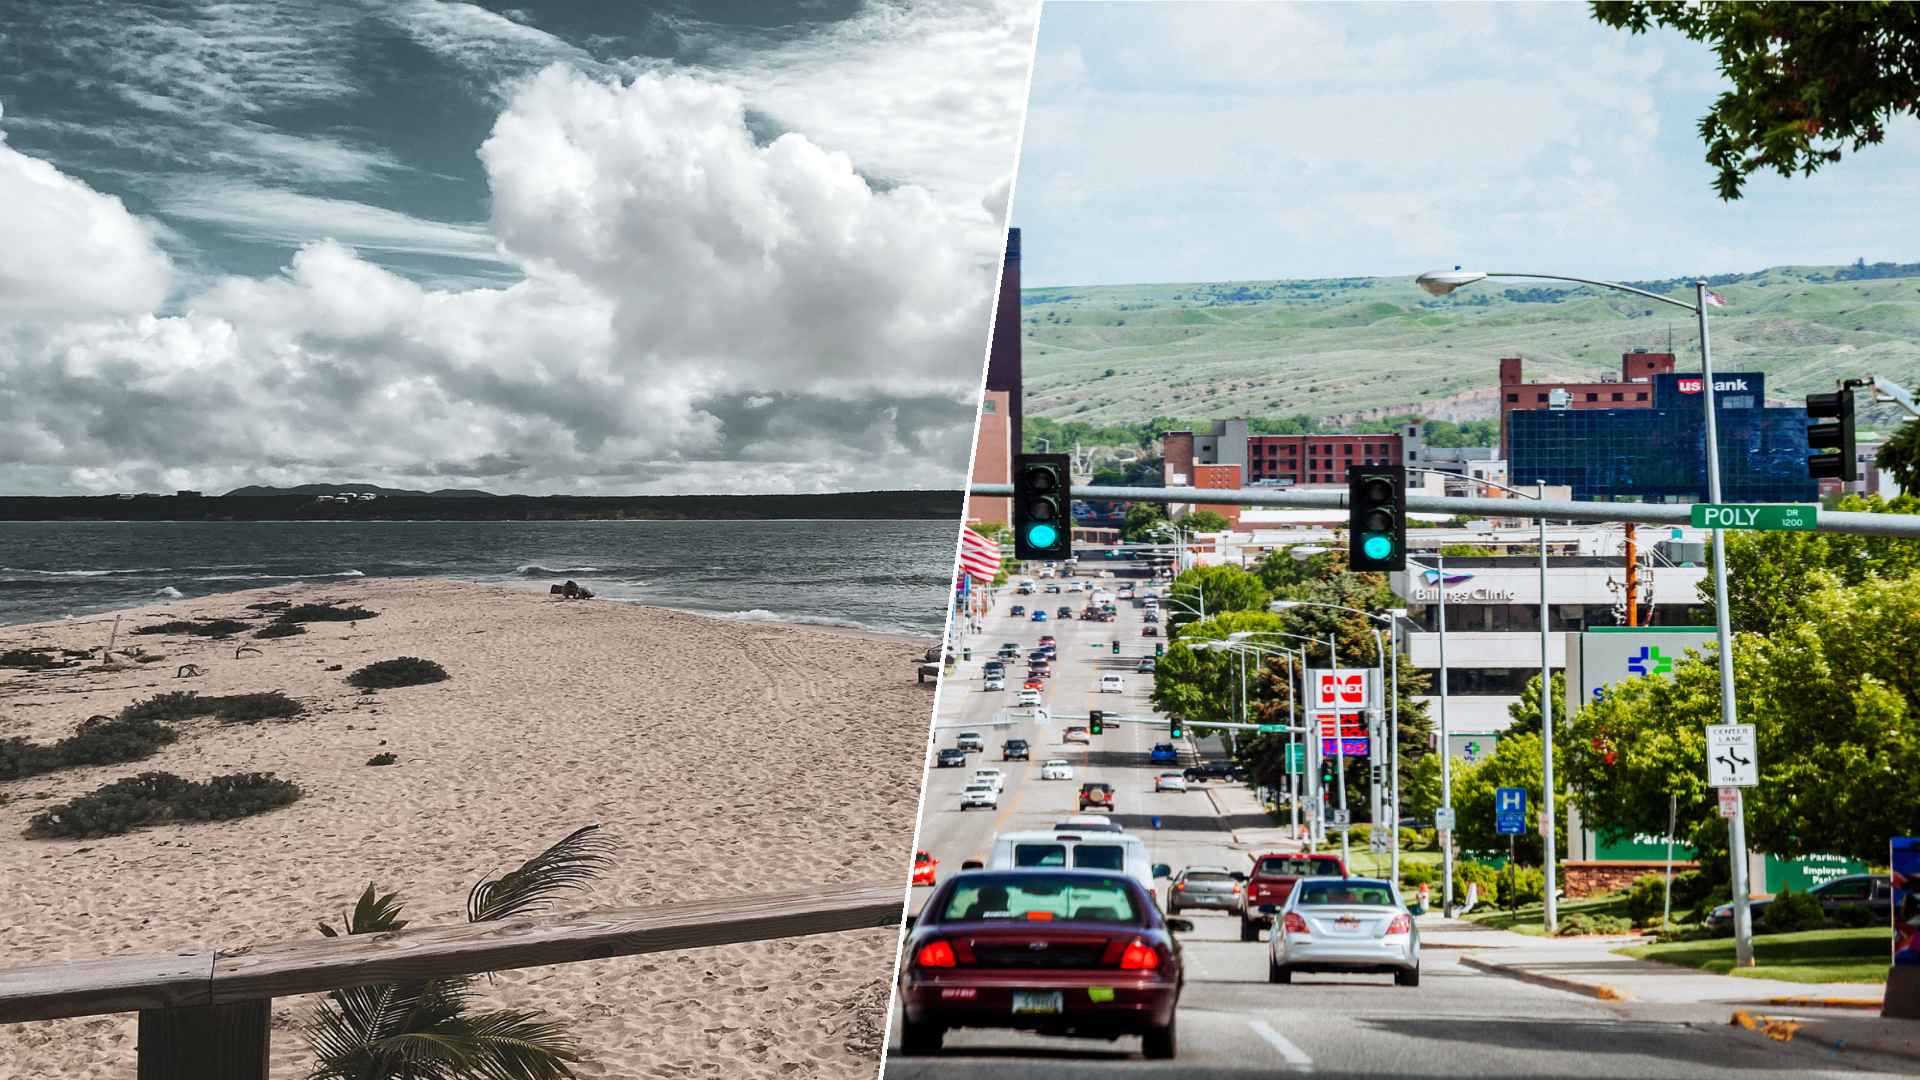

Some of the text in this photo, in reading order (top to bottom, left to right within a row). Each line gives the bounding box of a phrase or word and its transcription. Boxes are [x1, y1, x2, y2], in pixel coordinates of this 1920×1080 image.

[1712, 379, 1749, 391] ank
[1704, 508, 1760, 526] POLY
[1786, 509, 1798, 517] DR
[1782, 519, 1803, 527] 1200
[1415, 588, 1515, 603] Billngs Clinic
[1712, 727, 1748, 735] CENTER
[1503, 791, 1520, 810] H
[1803, 865, 1848, 876] Employee
